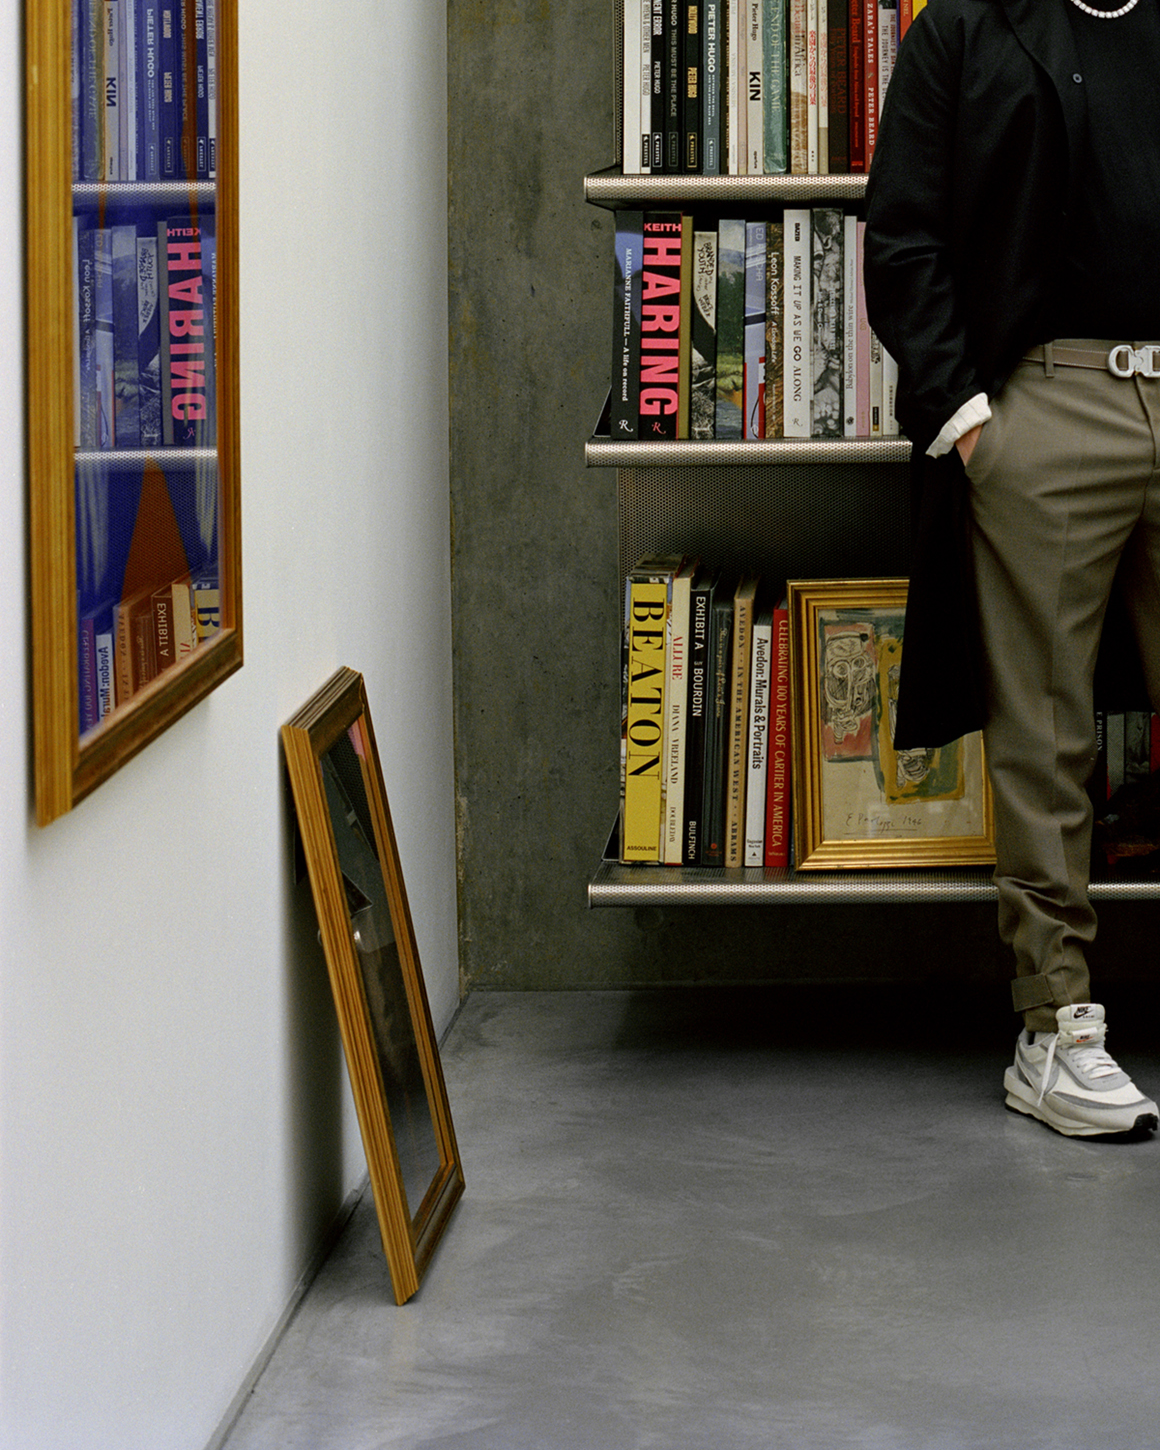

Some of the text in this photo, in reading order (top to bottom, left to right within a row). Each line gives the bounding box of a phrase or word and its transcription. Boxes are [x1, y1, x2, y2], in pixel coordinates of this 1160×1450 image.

[749, 71, 761, 101] KIN
[639, 237, 682, 415] HARING
[694, 596, 706, 640] EXHIBIT
[672, 636, 683, 680] ALLURE
[755, 638, 768, 678] Avedon:
[628, 598, 665, 780] BEATON
[692, 668, 704, 717] BOURDIN
[754, 679, 766, 714] Murals
[752, 725, 765, 769] Portraits
[772, 620, 788, 847] CELEBRATING 100 YEARS OF CARTIER IN AMERICA
